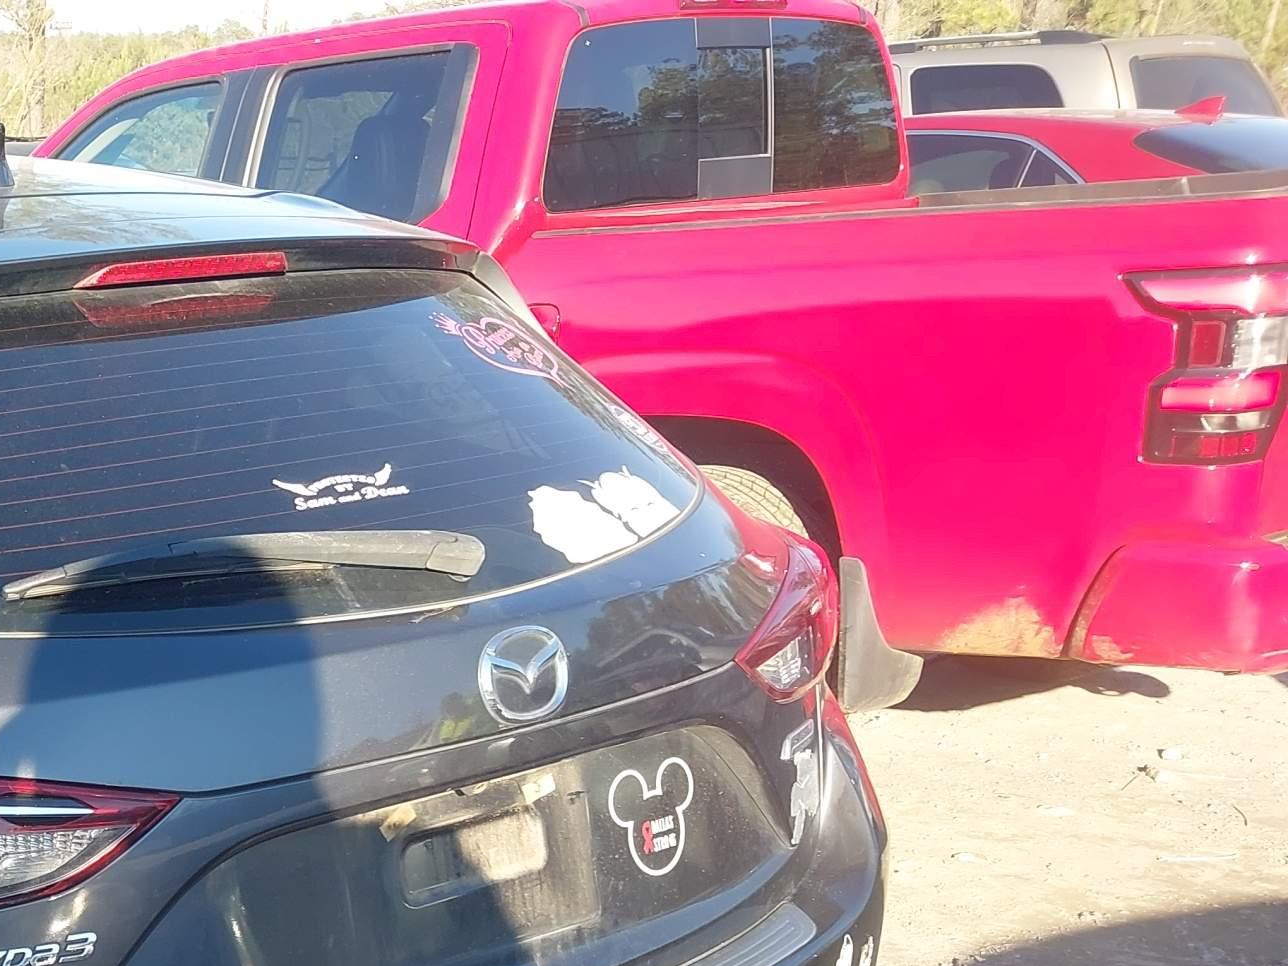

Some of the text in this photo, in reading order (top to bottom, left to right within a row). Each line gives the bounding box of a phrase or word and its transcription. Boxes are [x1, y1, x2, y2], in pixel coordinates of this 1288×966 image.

[294, 485, 410, 511] Sam and Dean
